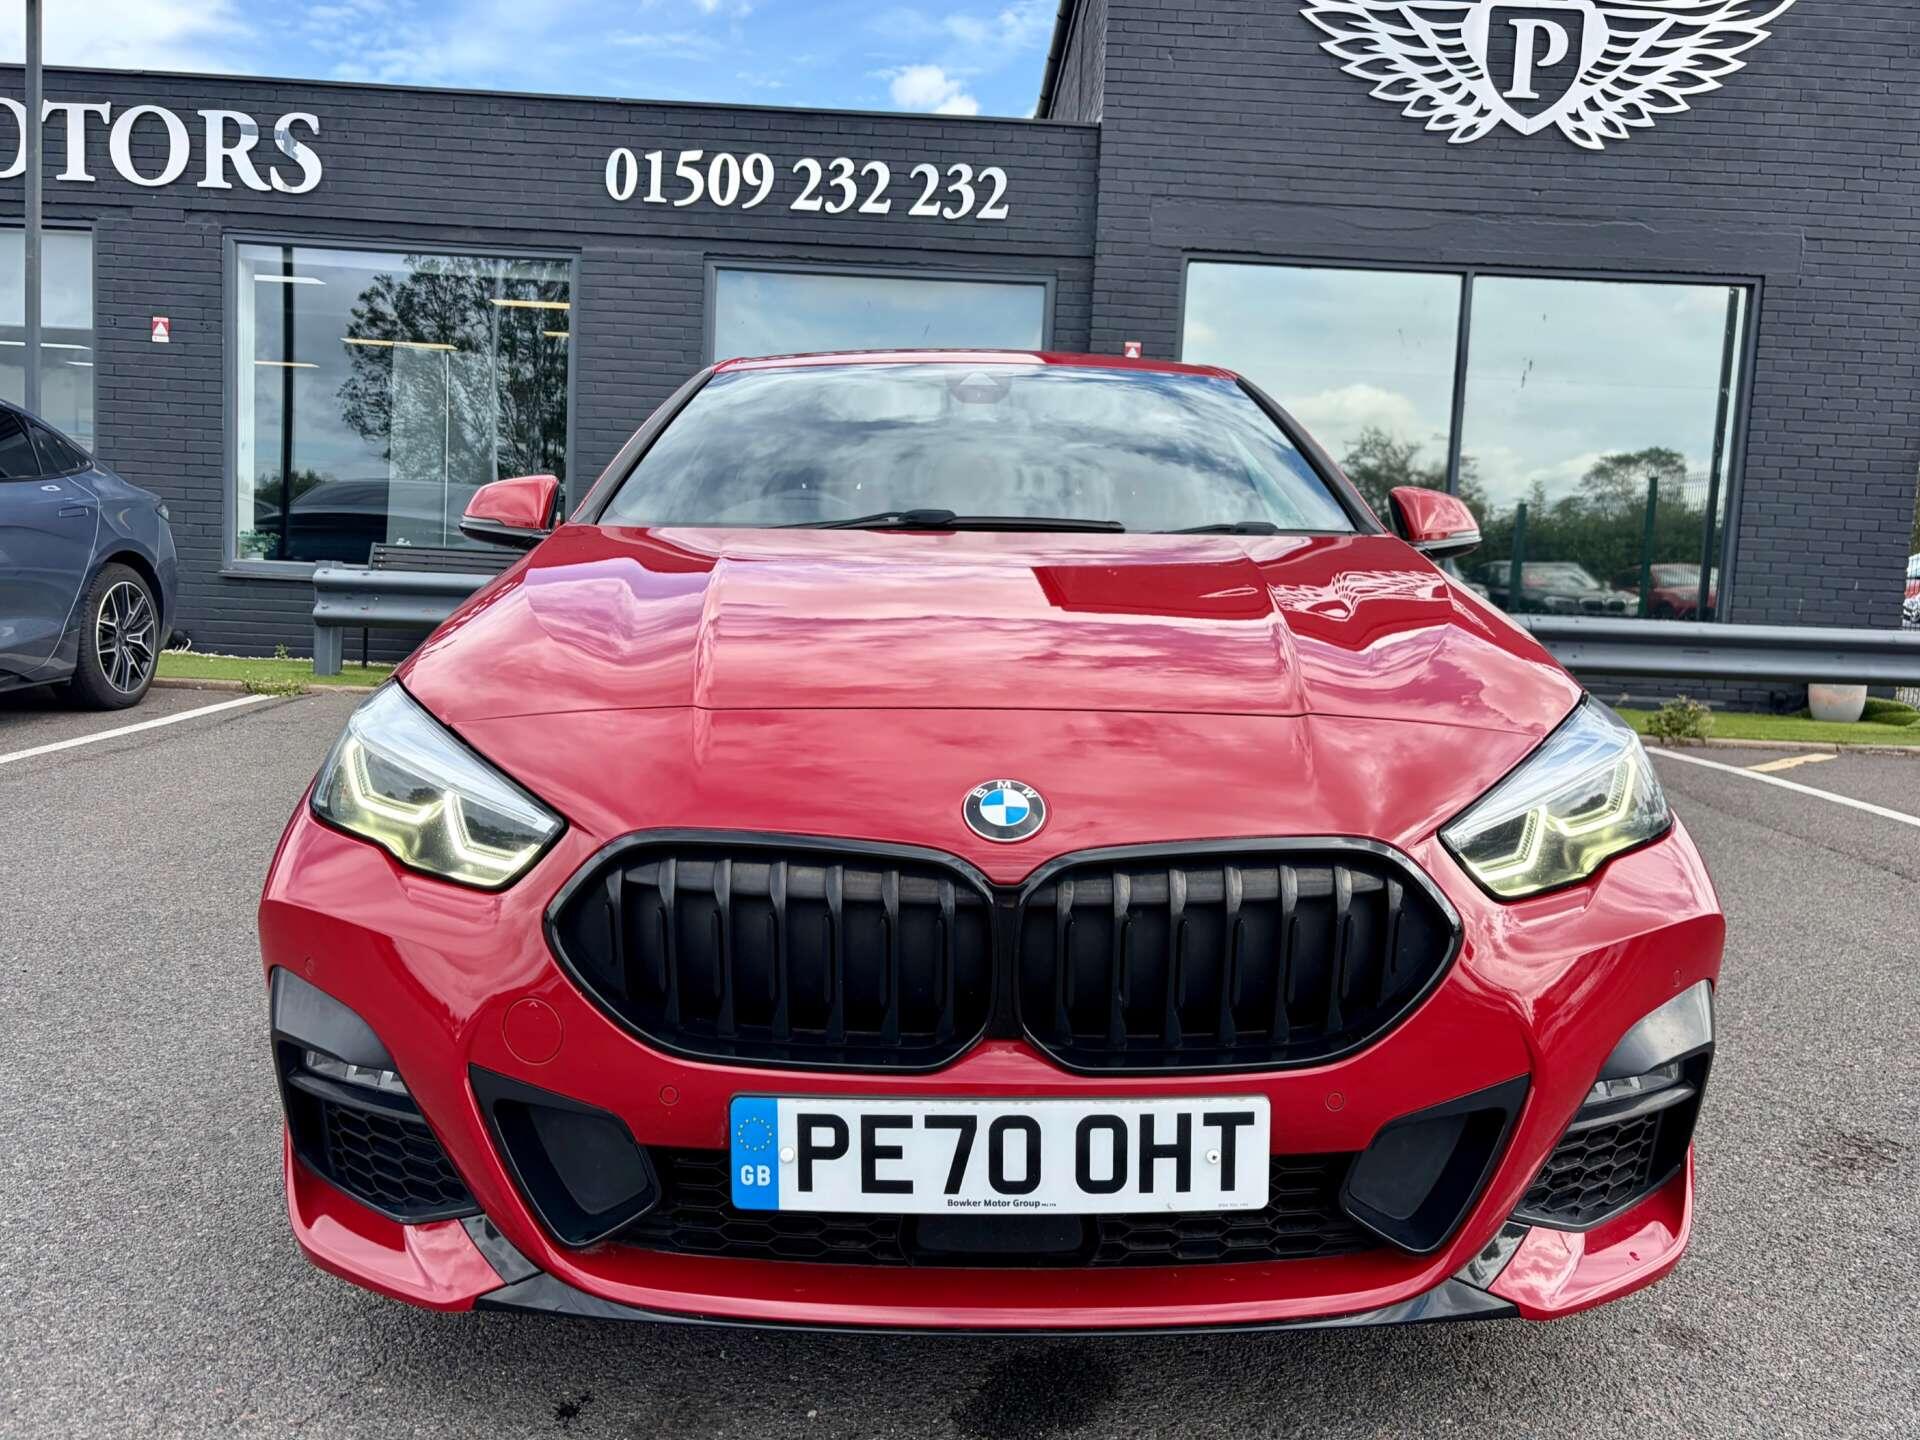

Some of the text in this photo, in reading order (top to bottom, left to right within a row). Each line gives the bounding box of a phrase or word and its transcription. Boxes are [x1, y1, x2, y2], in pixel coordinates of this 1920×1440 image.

[1502, 18, 1569, 99] P
[605, 147, 1009, 220] 01509 232 232
[973, 780, 1037, 799] BMW
[740, 1165, 771, 1186] GB
[796, 1111, 1255, 1195] PE70 OHT
[947, 1198, 982, 1207] Bowker
[983, 1198, 1011, 1207] Motor
[1012, 1198, 1041, 1209] Group
